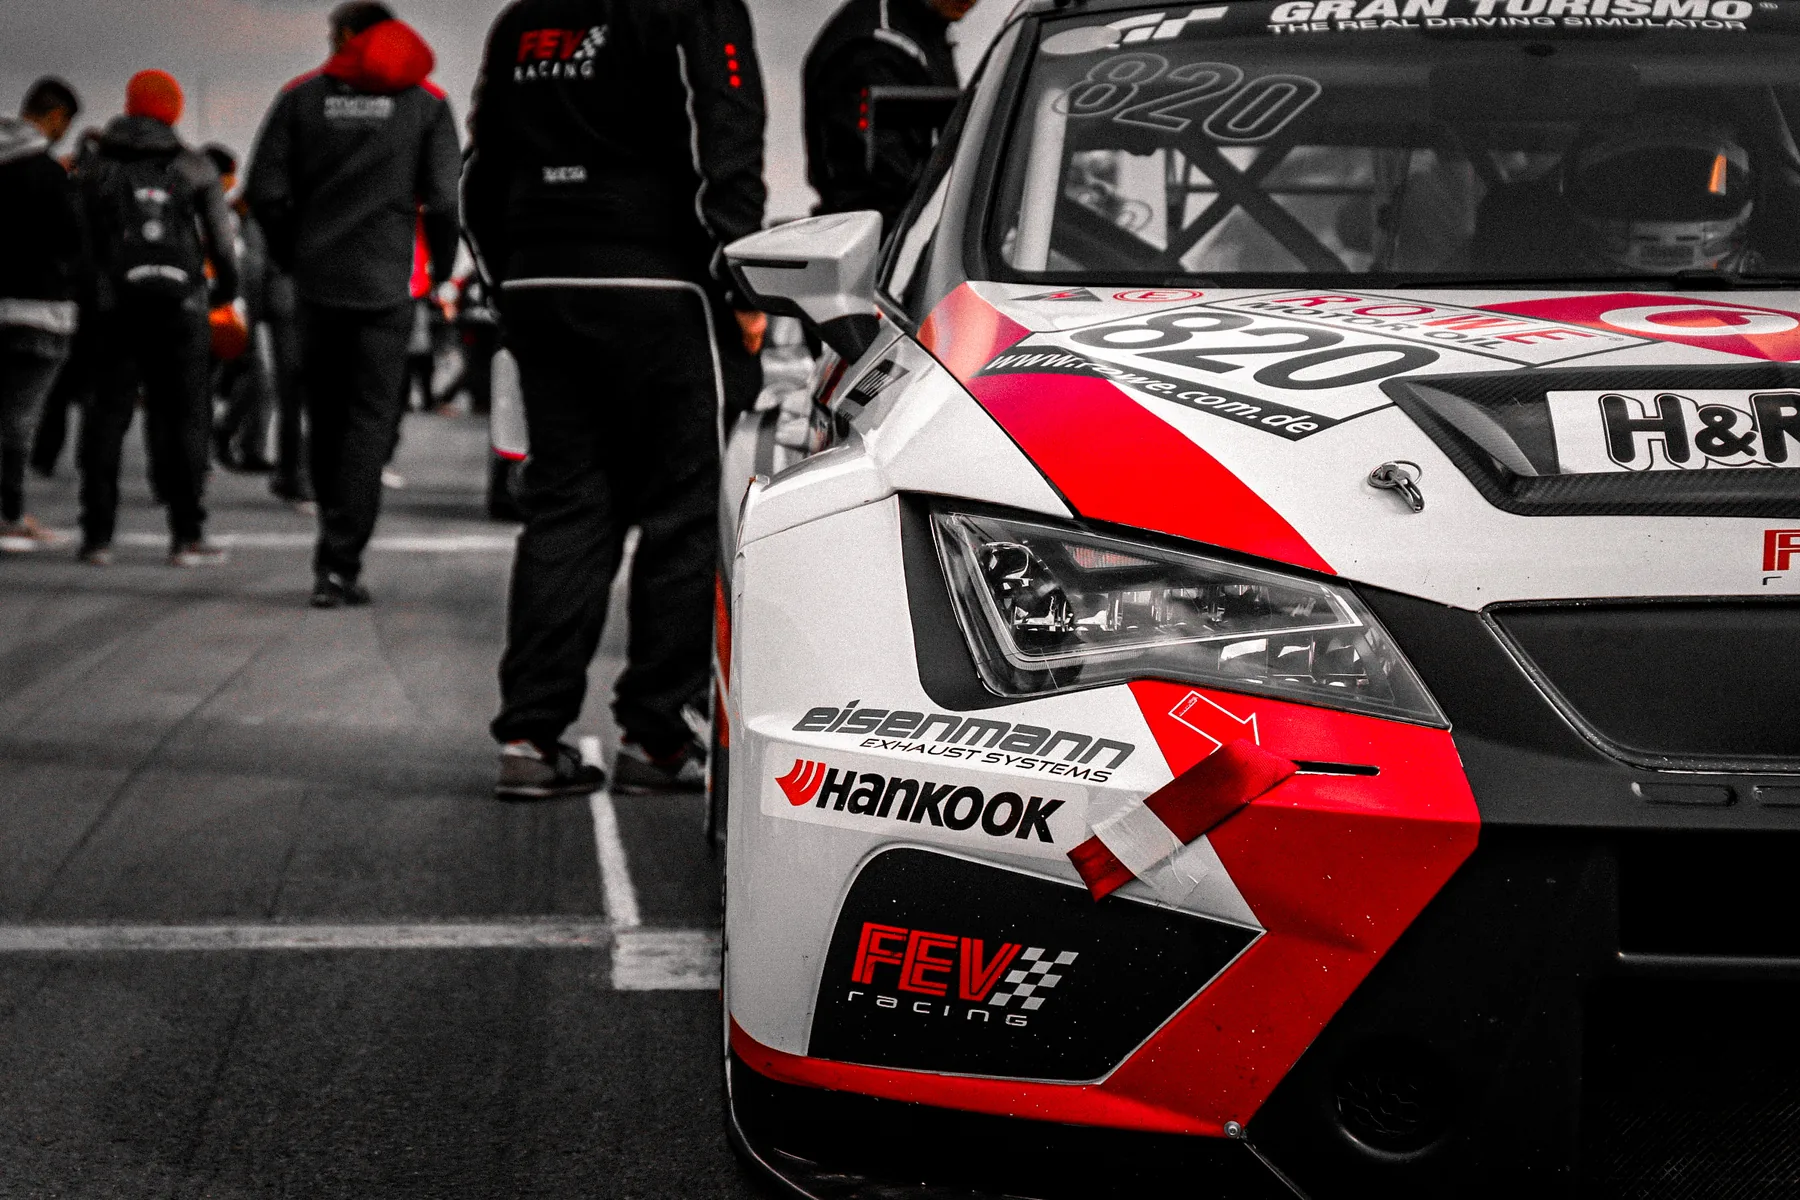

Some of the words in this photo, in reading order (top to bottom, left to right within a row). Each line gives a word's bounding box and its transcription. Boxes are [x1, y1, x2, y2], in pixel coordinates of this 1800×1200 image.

[1267, 22, 1330, 33] THE
[1337, 18, 1420, 30] REAL
[1426, 17, 1556, 29] DRIVING
[1563, 16, 1747, 31] SIMULATOR
[1269, 0, 1450, 22] GRAN
[1469, 0, 1753, 20] TURISMO
[517, 28, 584, 62] FEV
[513, 60, 595, 82] RACING
[1052, 52, 1322, 142] 820
[1238, 302, 1418, 331] MOTOR
[1424, 331, 1506, 349] OIL
[1271, 295, 1597, 344] ROWE
[1069, 312, 1440, 390] 820
[985, 352, 1319, 434] www.rowe.com.de
[792, 699, 1135, 769] eisenmann
[860, 738, 982, 761] EXHAUST
[981, 752, 1112, 783] SYSTEMS
[852, 922, 1022, 1001] FEV
